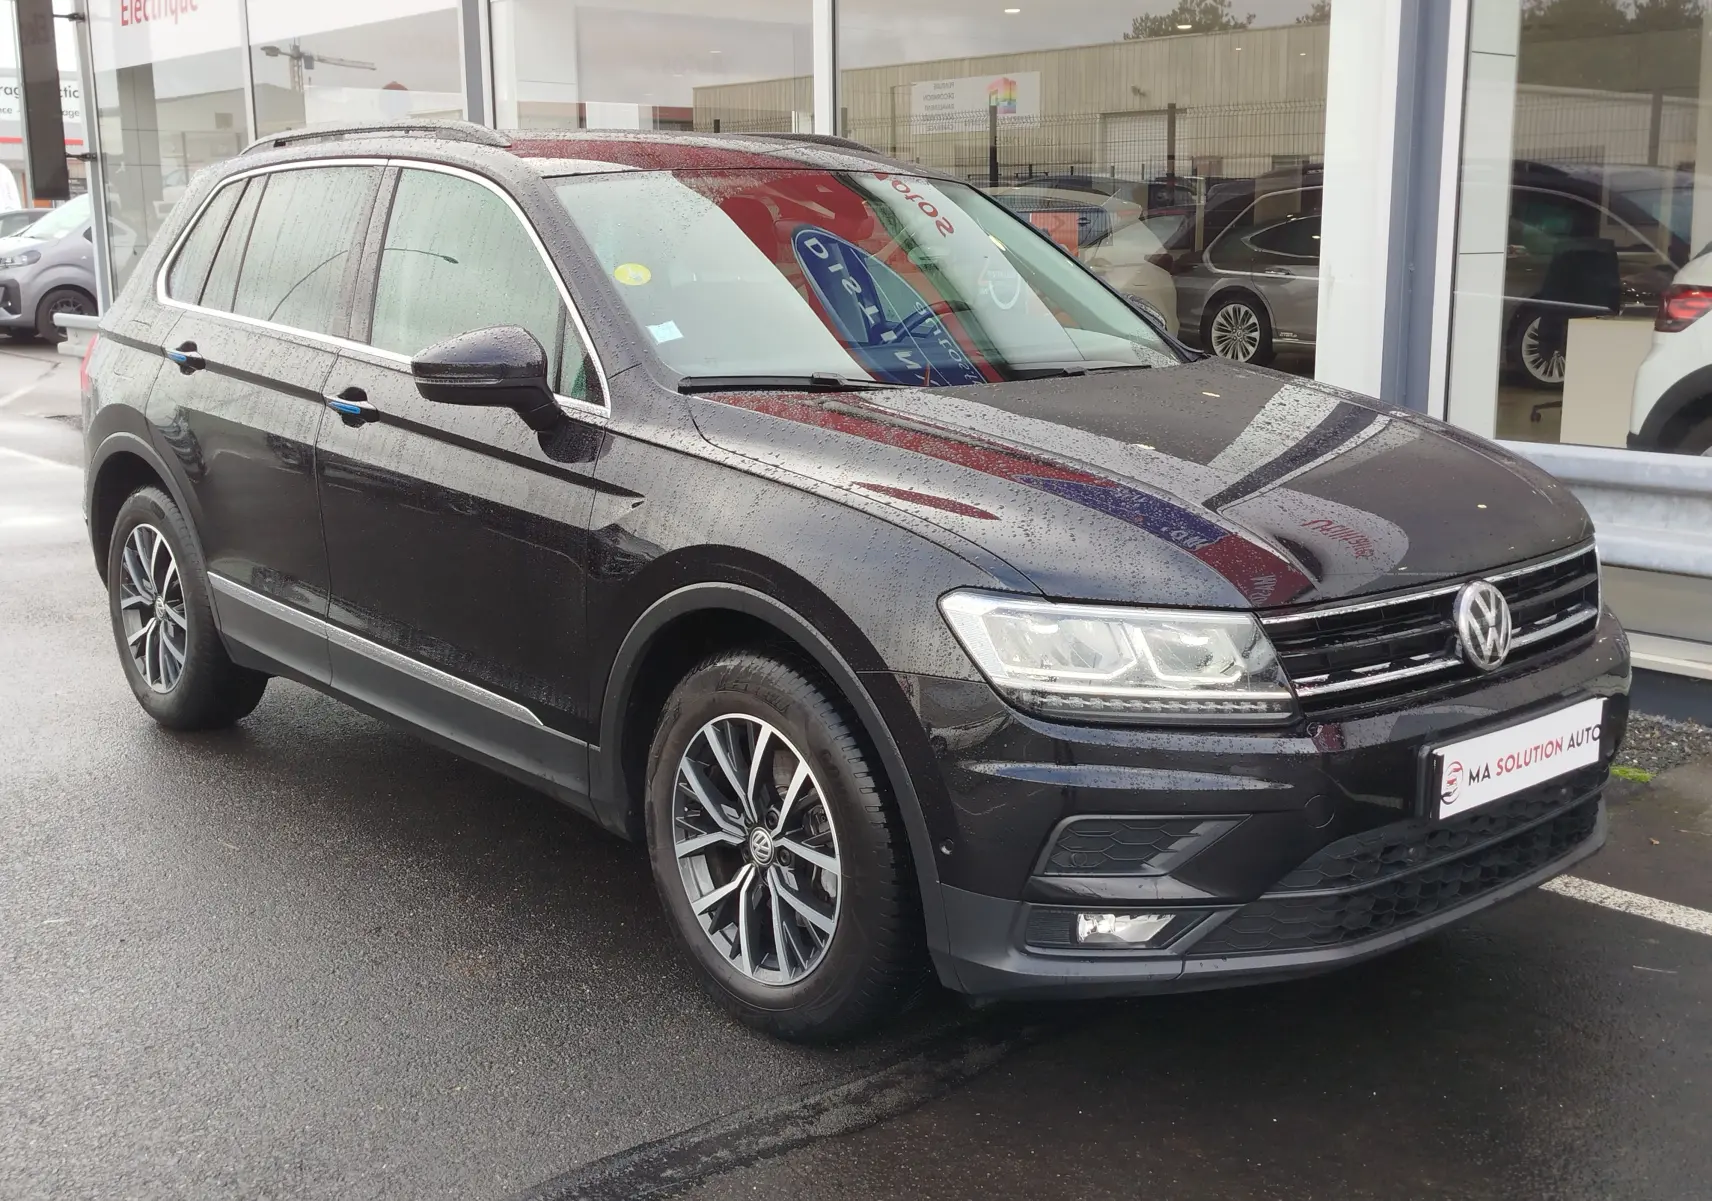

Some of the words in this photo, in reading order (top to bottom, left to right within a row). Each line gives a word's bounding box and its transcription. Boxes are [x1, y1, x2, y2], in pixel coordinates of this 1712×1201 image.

[1468, 762, 1491, 786] MA
[1496, 736, 1564, 777] SOLUTION
[1567, 723, 1601, 751] AUTO
